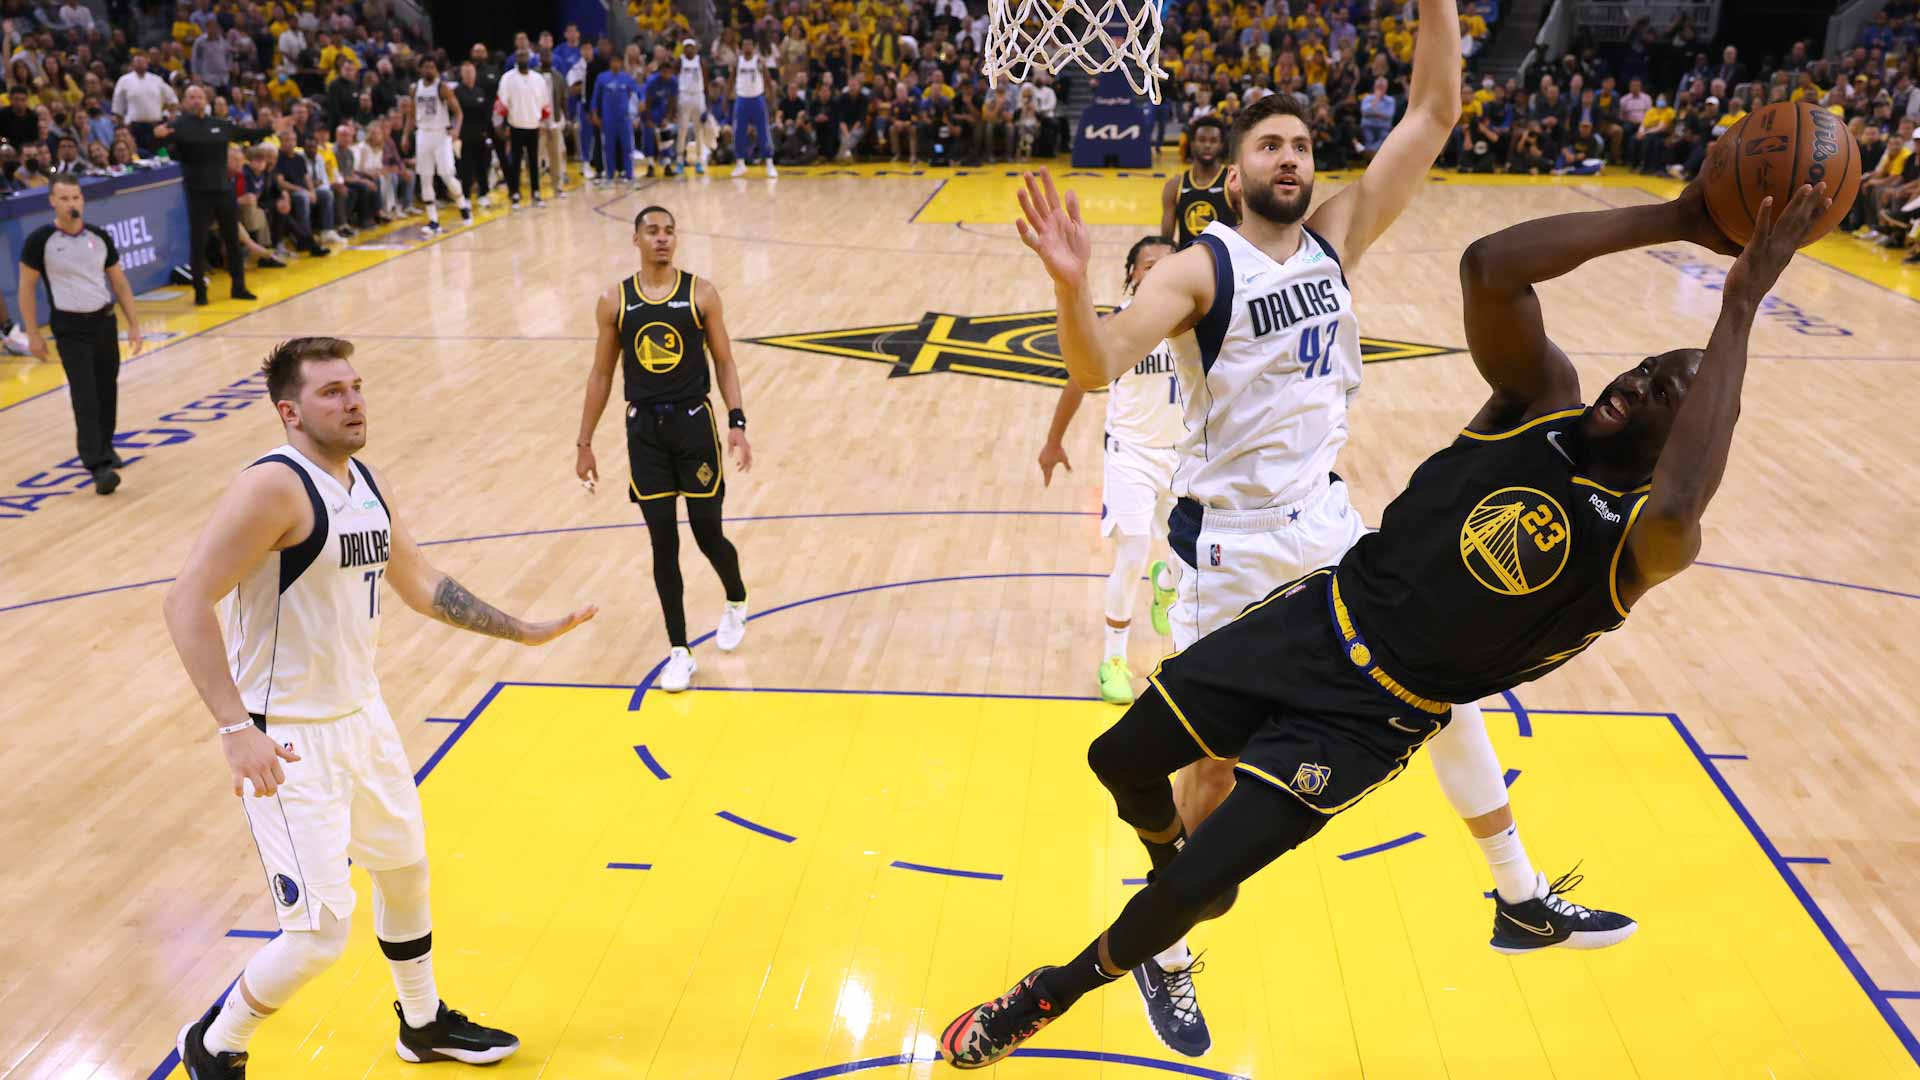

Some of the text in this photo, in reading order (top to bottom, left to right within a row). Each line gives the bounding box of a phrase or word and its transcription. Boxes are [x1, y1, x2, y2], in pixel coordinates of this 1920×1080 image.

[1808, 109, 1840, 184] Wilso
[104, 215, 153, 249] DUEL
[1247, 279, 1341, 338] DALLAS
[663, 333, 676, 349] 3
[1298, 320, 1339, 379] 42
[1134, 353, 1174, 375] DALL
[159, 370, 270, 423] CENT
[1168, 376, 1181, 405] 1
[1519, 503, 1567, 553] 23
[1588, 493, 1622, 525] Rakuten
[338, 528, 390, 569] DALLAS
